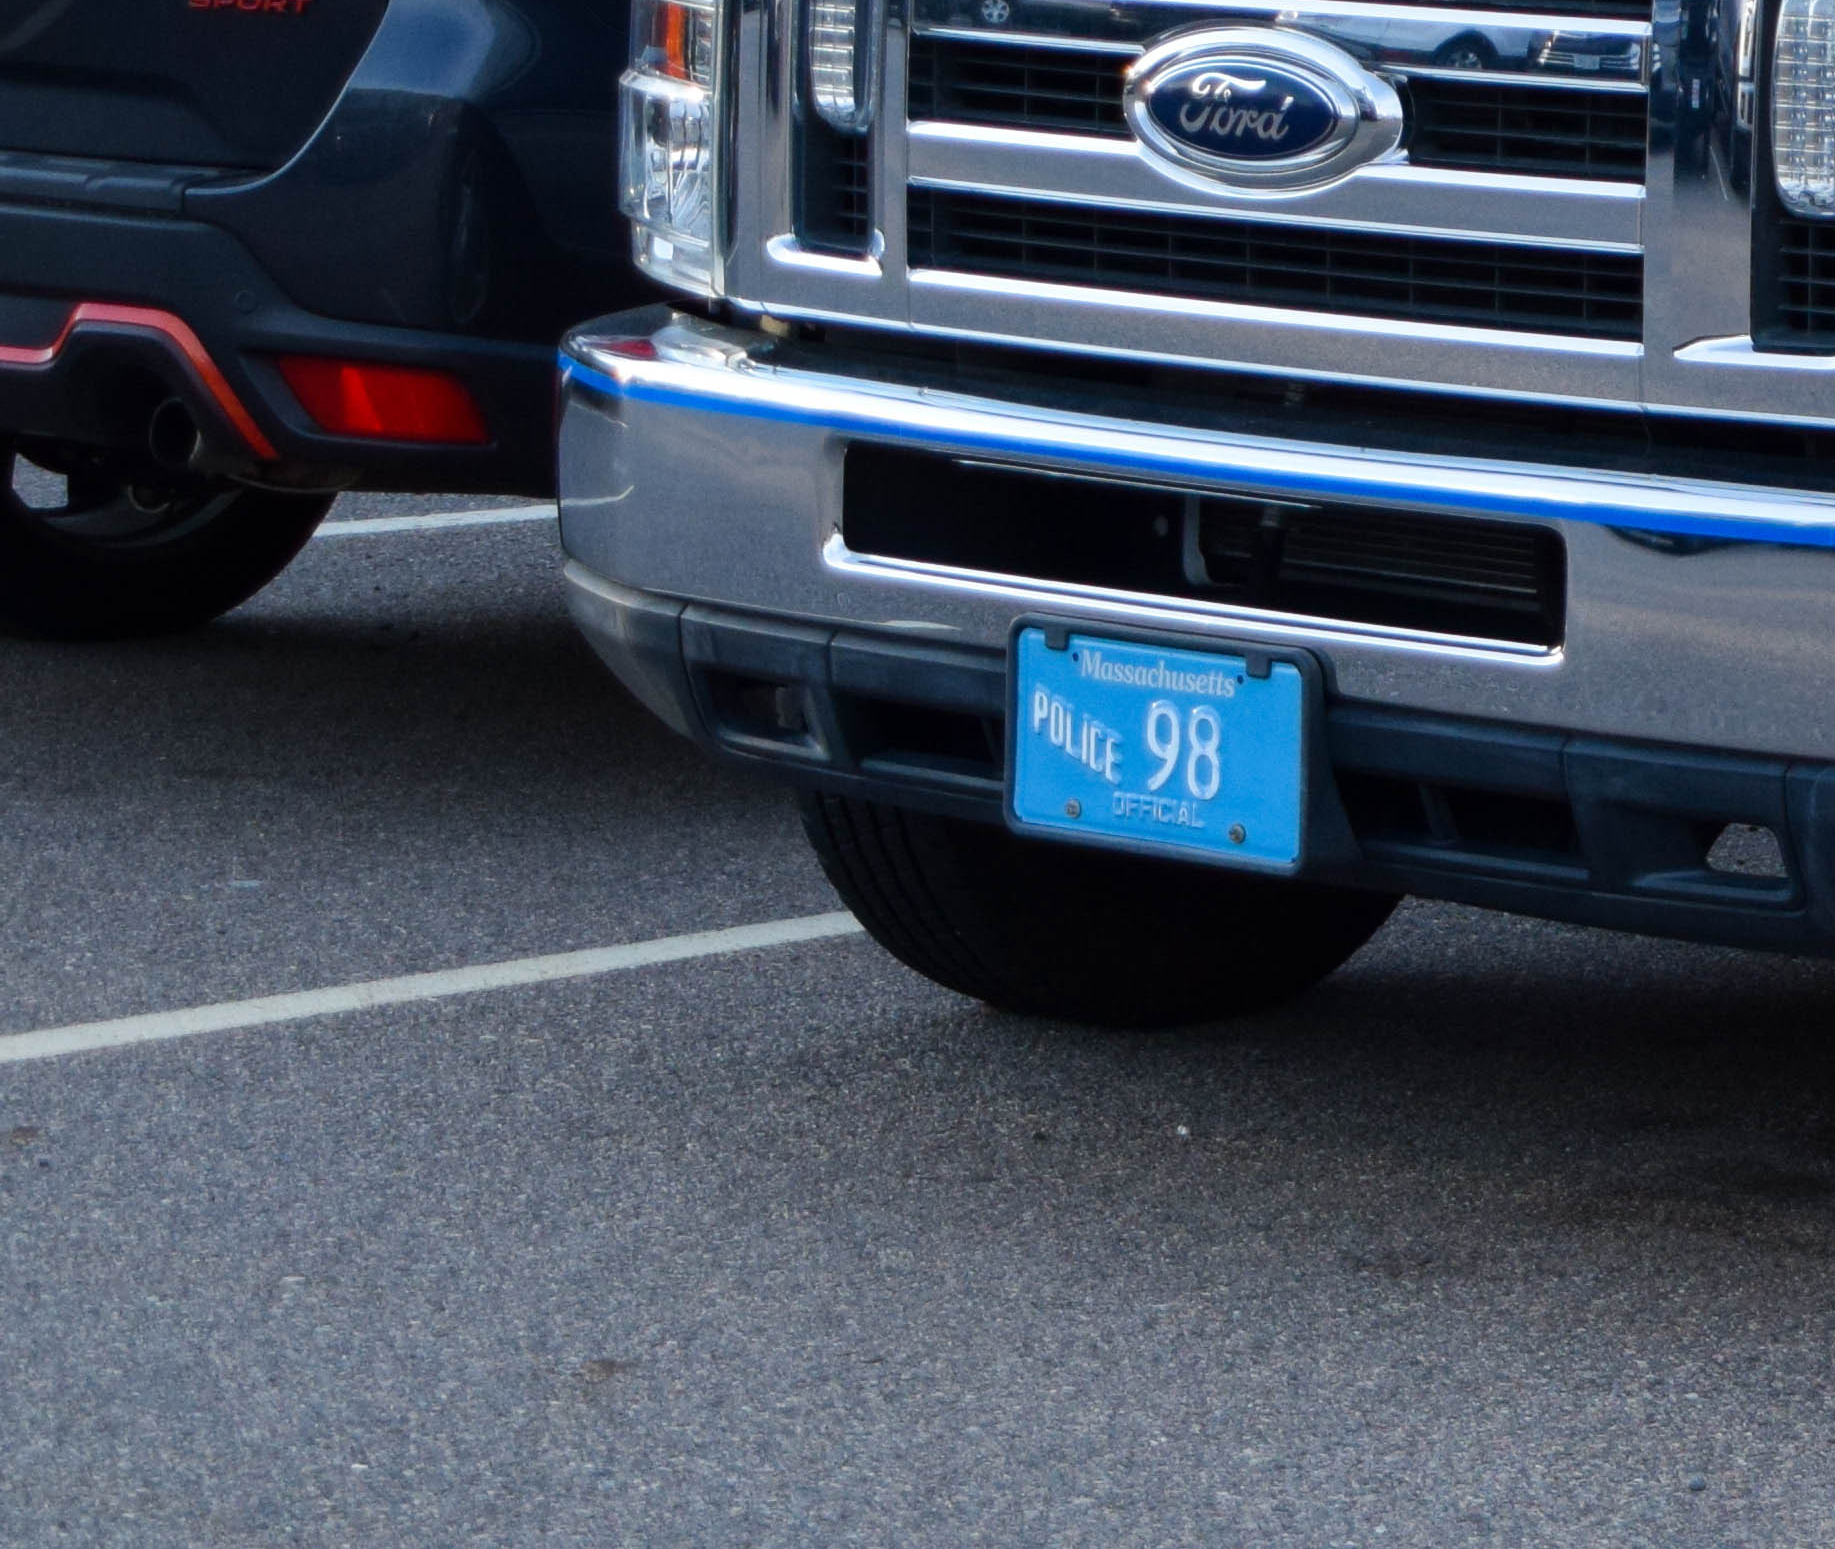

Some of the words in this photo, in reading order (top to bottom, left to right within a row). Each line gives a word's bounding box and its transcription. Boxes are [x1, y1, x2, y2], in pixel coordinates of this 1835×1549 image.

[1179, 71, 1294, 140] Ford
[1081, 649, 1236, 698] Massachusetts
[1032, 683, 1123, 784] POLICE
[1147, 699, 1221, 800] 98
[1112, 791, 1206, 829] OFFICIAL
